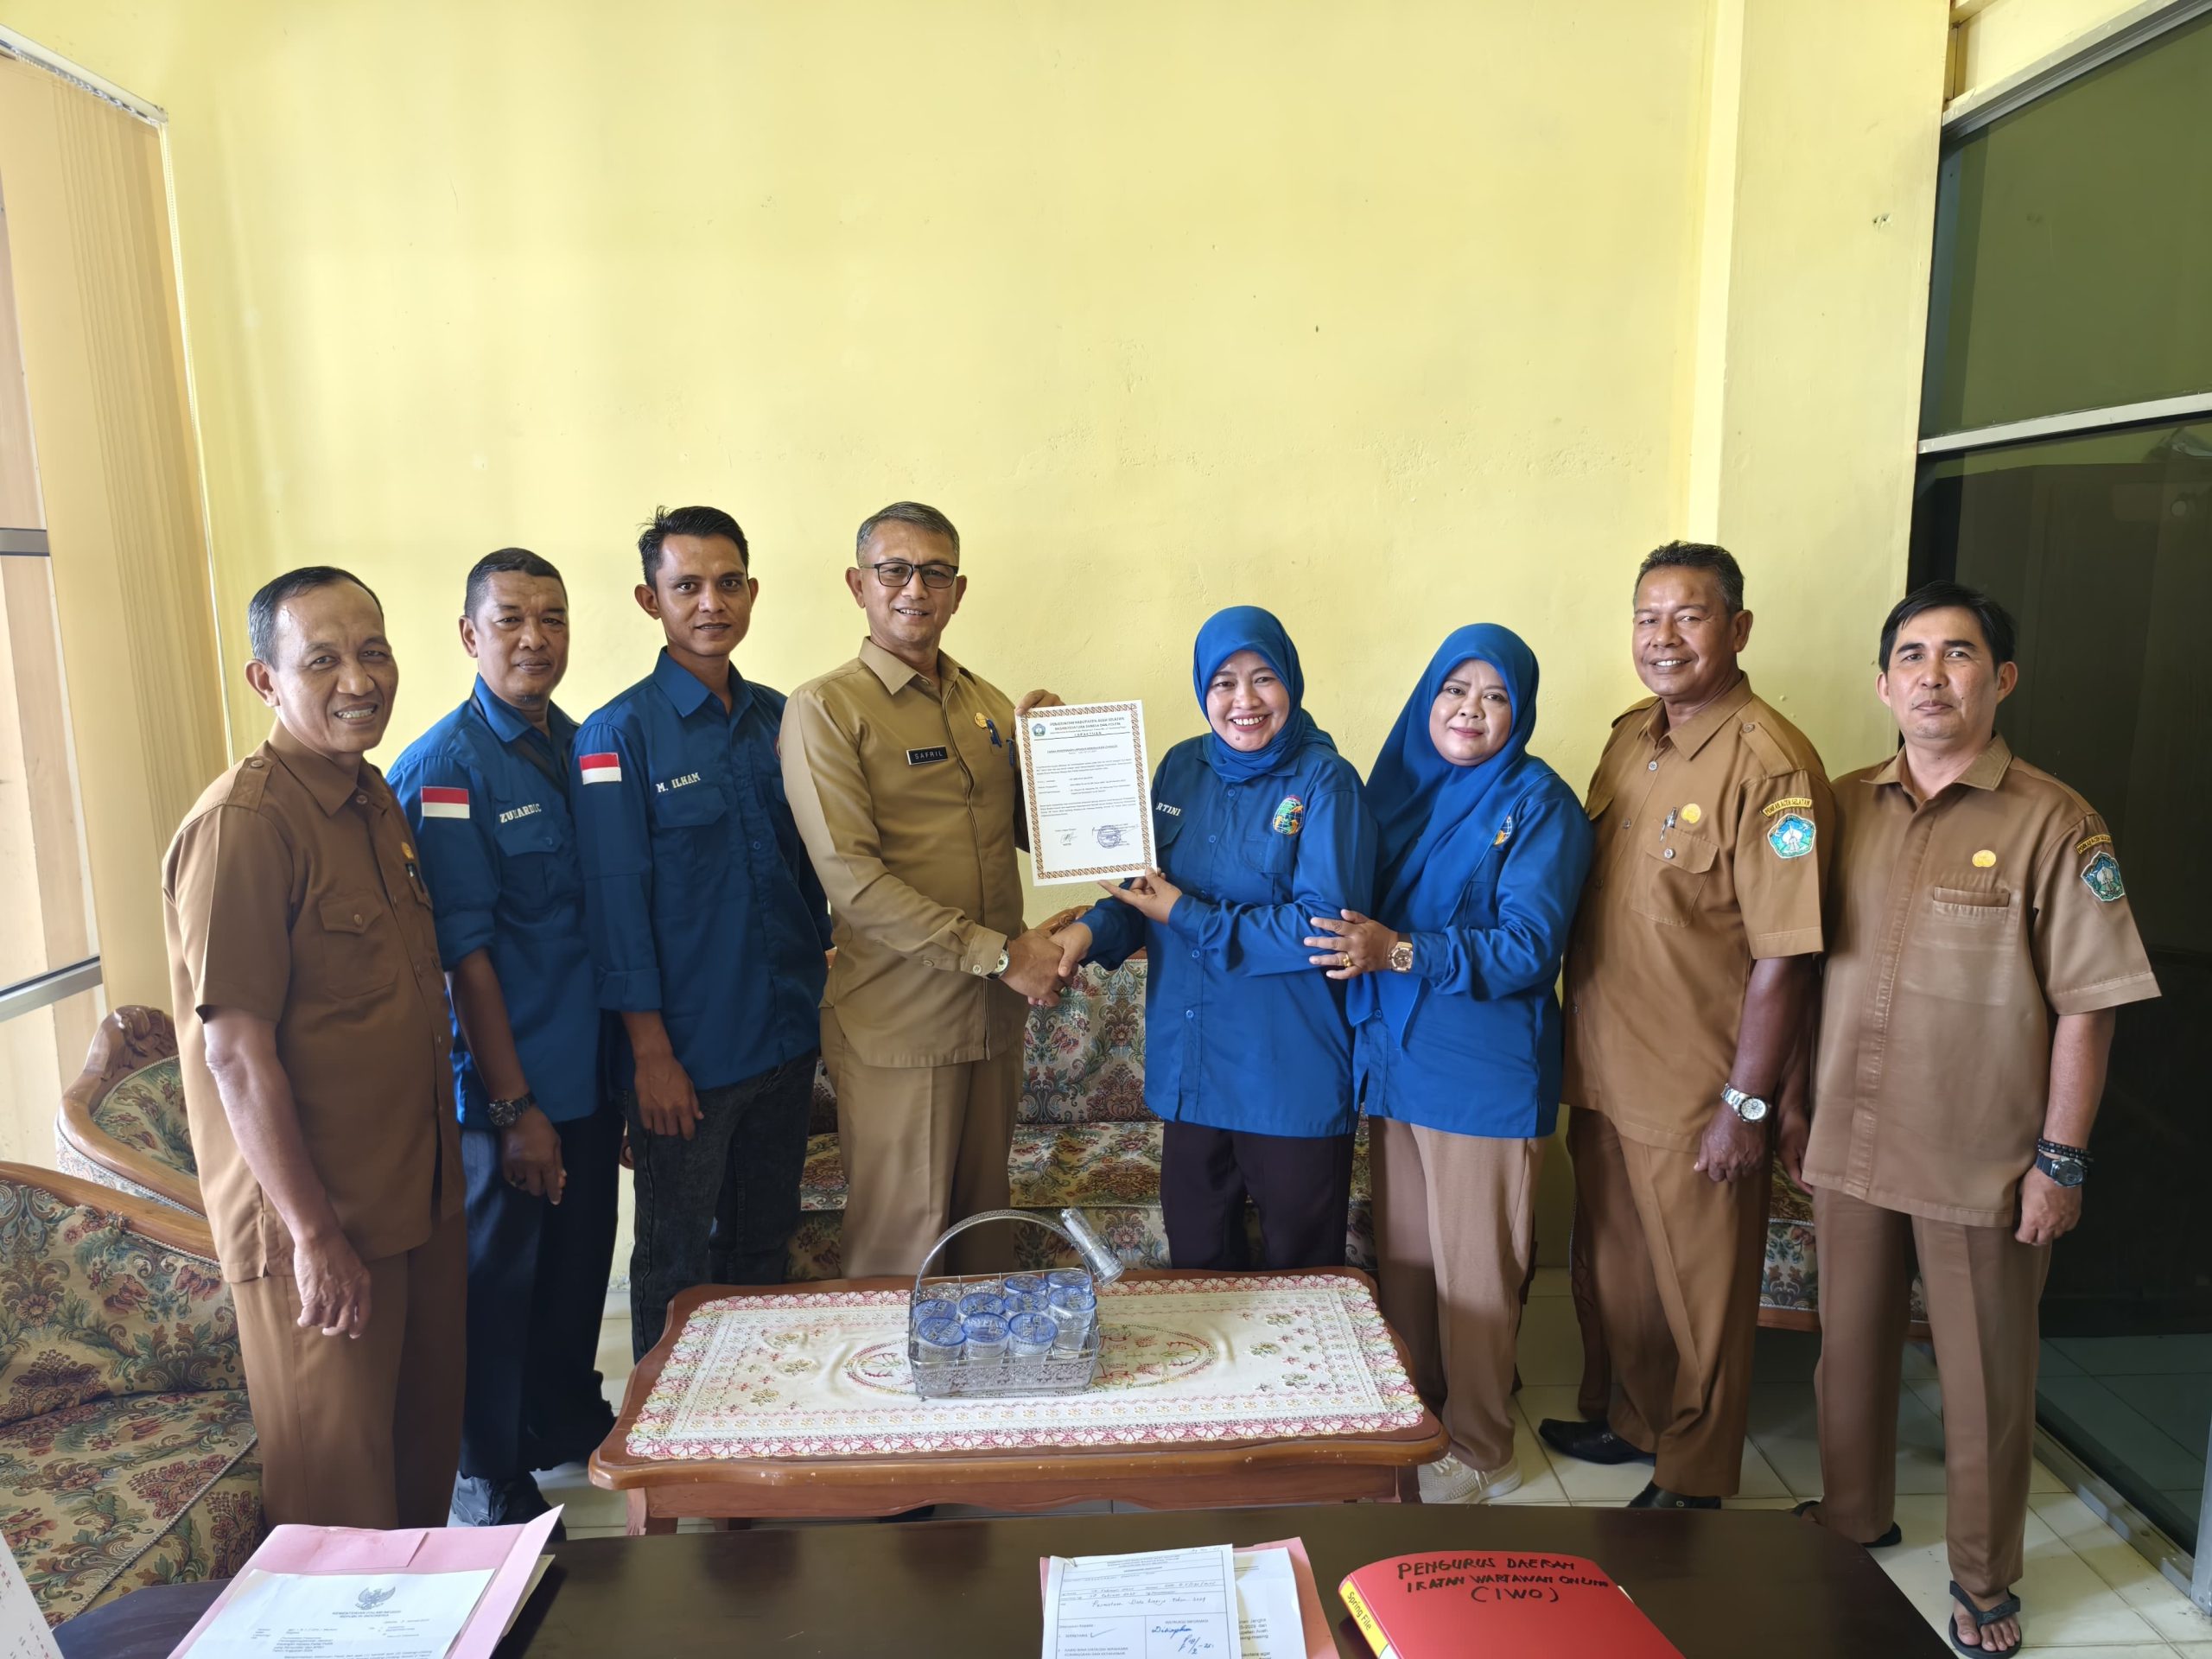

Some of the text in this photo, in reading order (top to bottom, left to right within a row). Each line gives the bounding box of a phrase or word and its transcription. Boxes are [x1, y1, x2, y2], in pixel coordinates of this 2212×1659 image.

[914, 750, 944, 760] SAFRIL
[656, 772, 701, 792] M. ILHAM
[1397, 1558, 1574, 1580] PENGURUS DAERAH
[1408, 1577, 1465, 1592] IKATAN
[1470, 1574, 1553, 1584] WARTAWAN
[1347, 1592, 1372, 1630] Spring File
